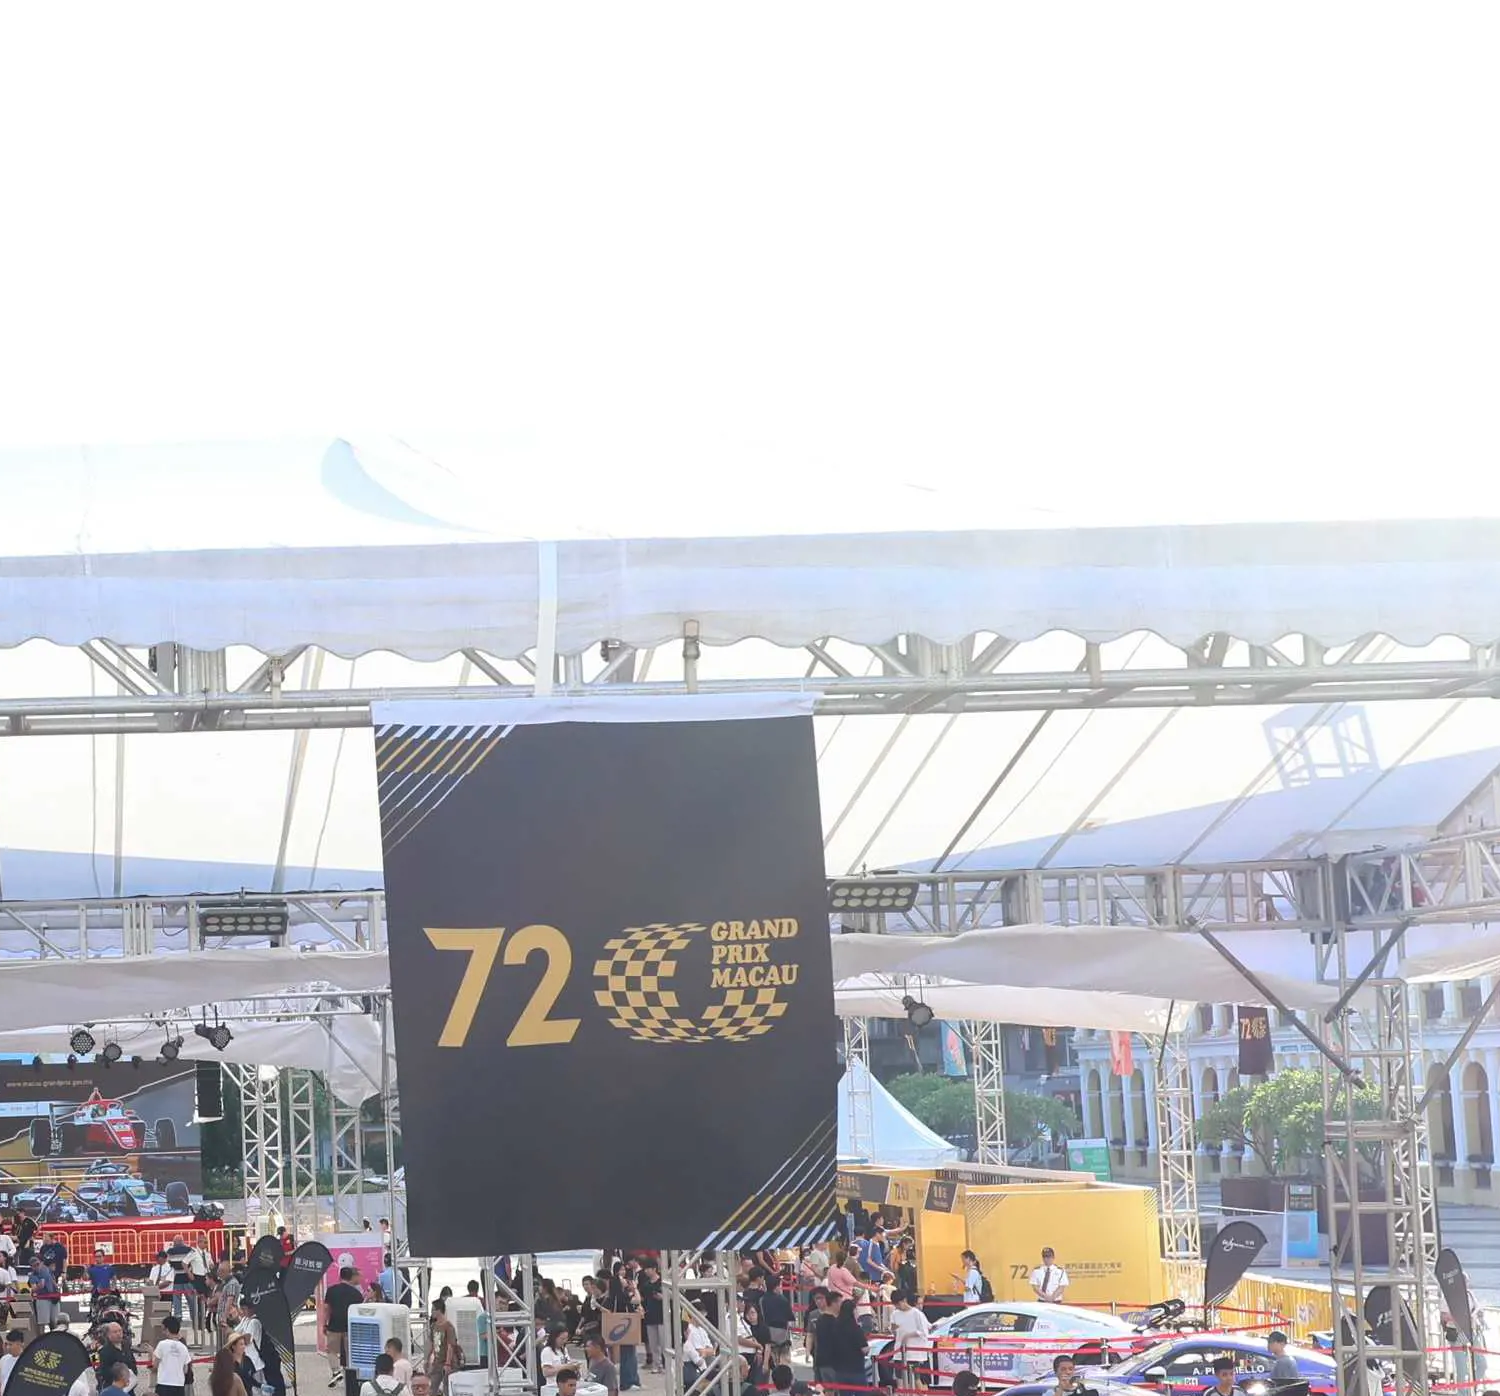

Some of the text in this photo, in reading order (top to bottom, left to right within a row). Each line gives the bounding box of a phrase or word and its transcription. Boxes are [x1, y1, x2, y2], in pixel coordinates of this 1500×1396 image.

[710, 917, 798, 941] GRAND
[710, 944, 769, 965] PRIX
[423, 924, 582, 1047] 72
[710, 964, 799, 988] MACAU
[1010, 1265, 1029, 1280] 72
